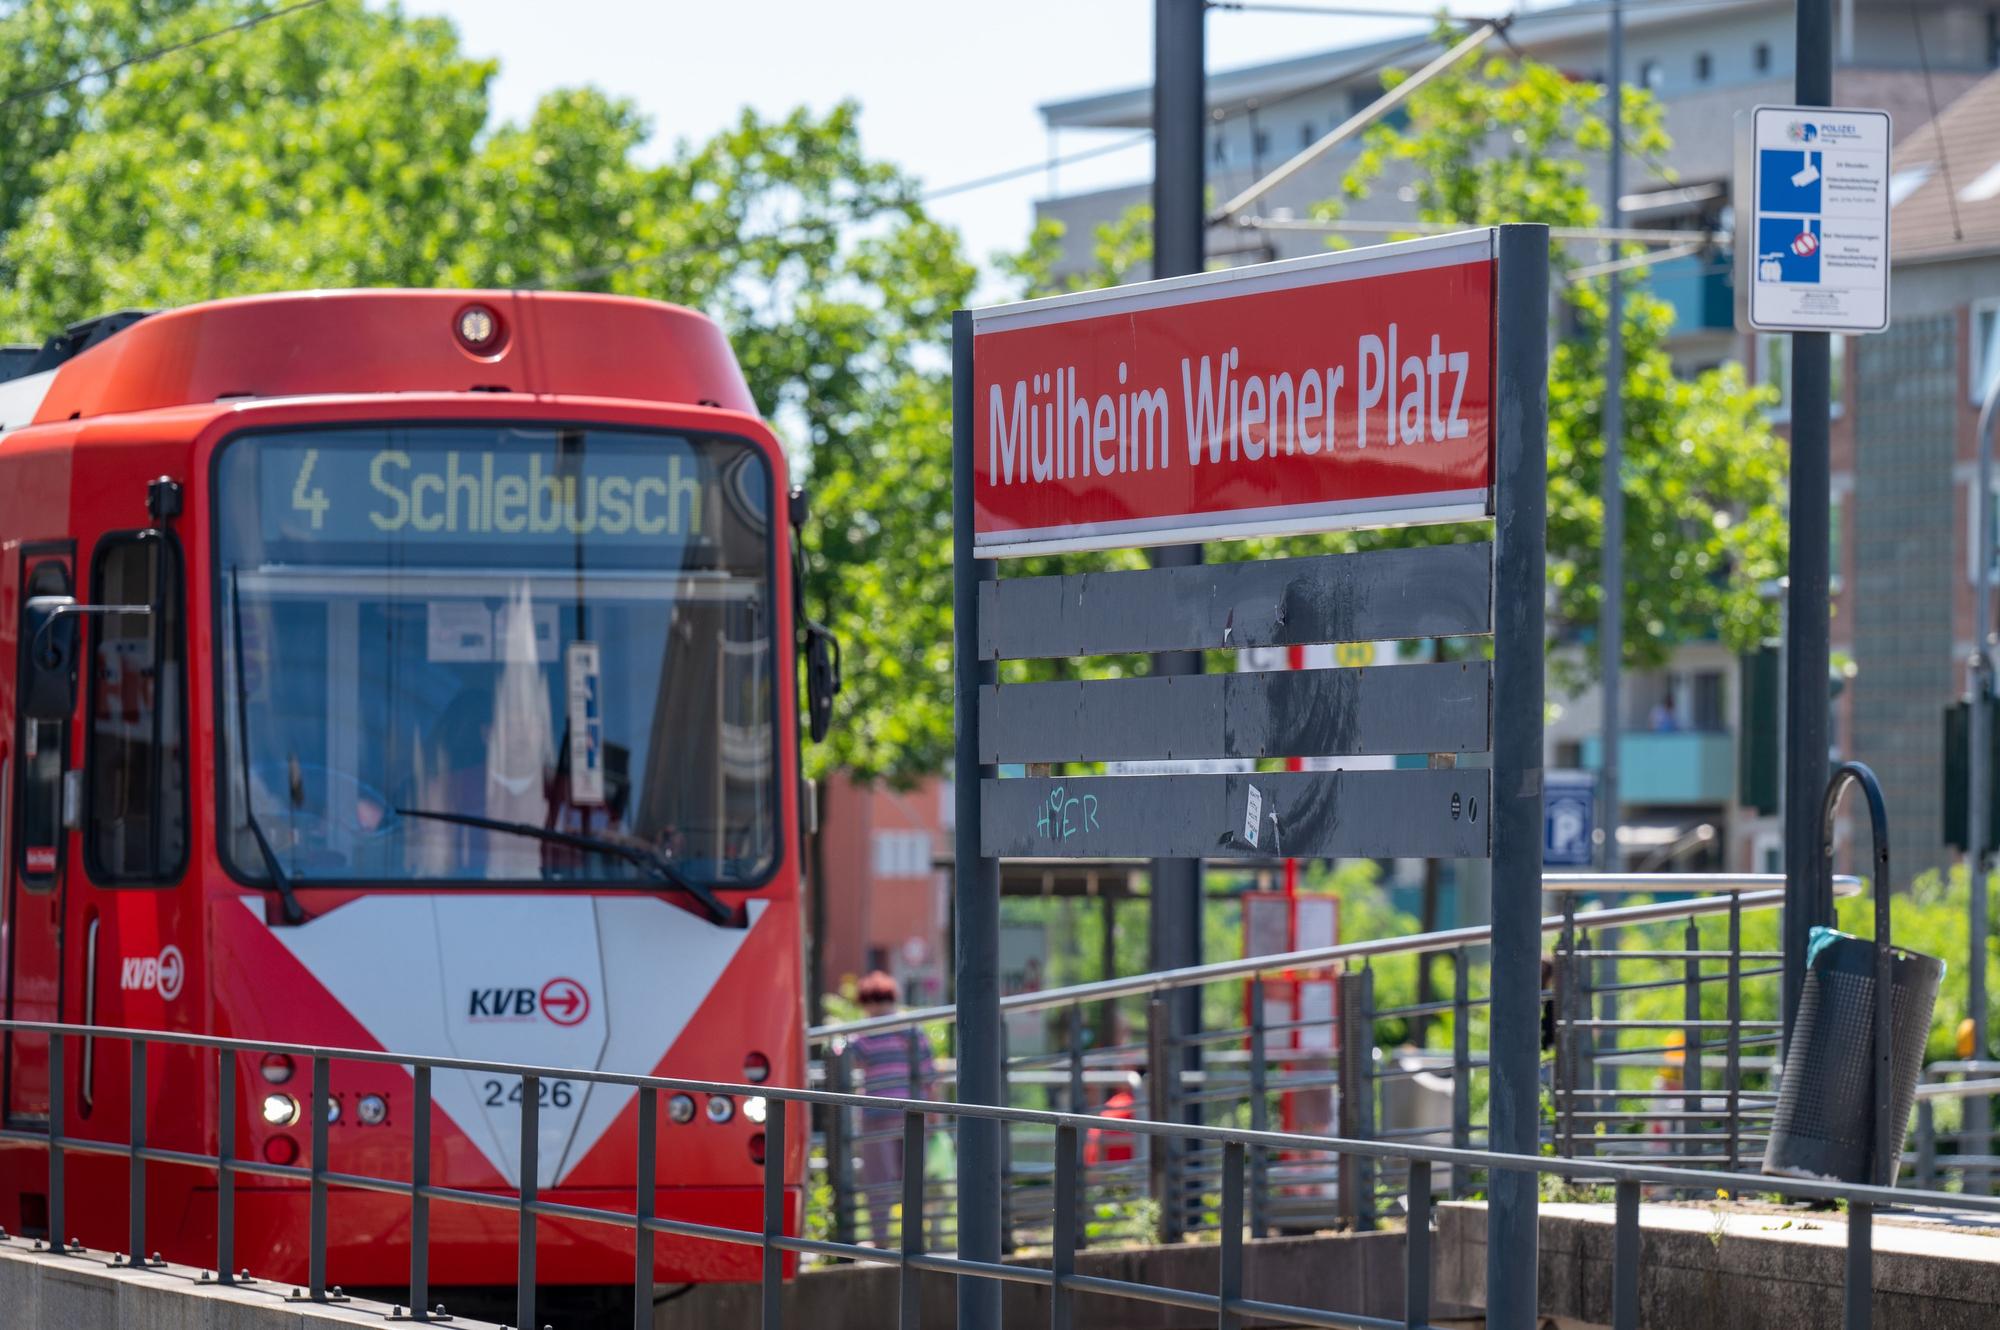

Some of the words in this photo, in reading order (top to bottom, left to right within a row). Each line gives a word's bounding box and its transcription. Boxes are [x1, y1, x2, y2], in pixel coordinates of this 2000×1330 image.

[1821, 124, 1857, 134] POLIZEI
[989, 361, 1169, 486] Mülheim
[1181, 346, 1345, 467] Wiener
[1357, 322, 1470, 449] Platz
[292, 449, 330, 530] 4
[368, 449, 702, 536] Schlebusch
[1554, 812, 1582, 850] P
[120, 957, 158, 990] KVB
[469, 988, 537, 1016] KVB
